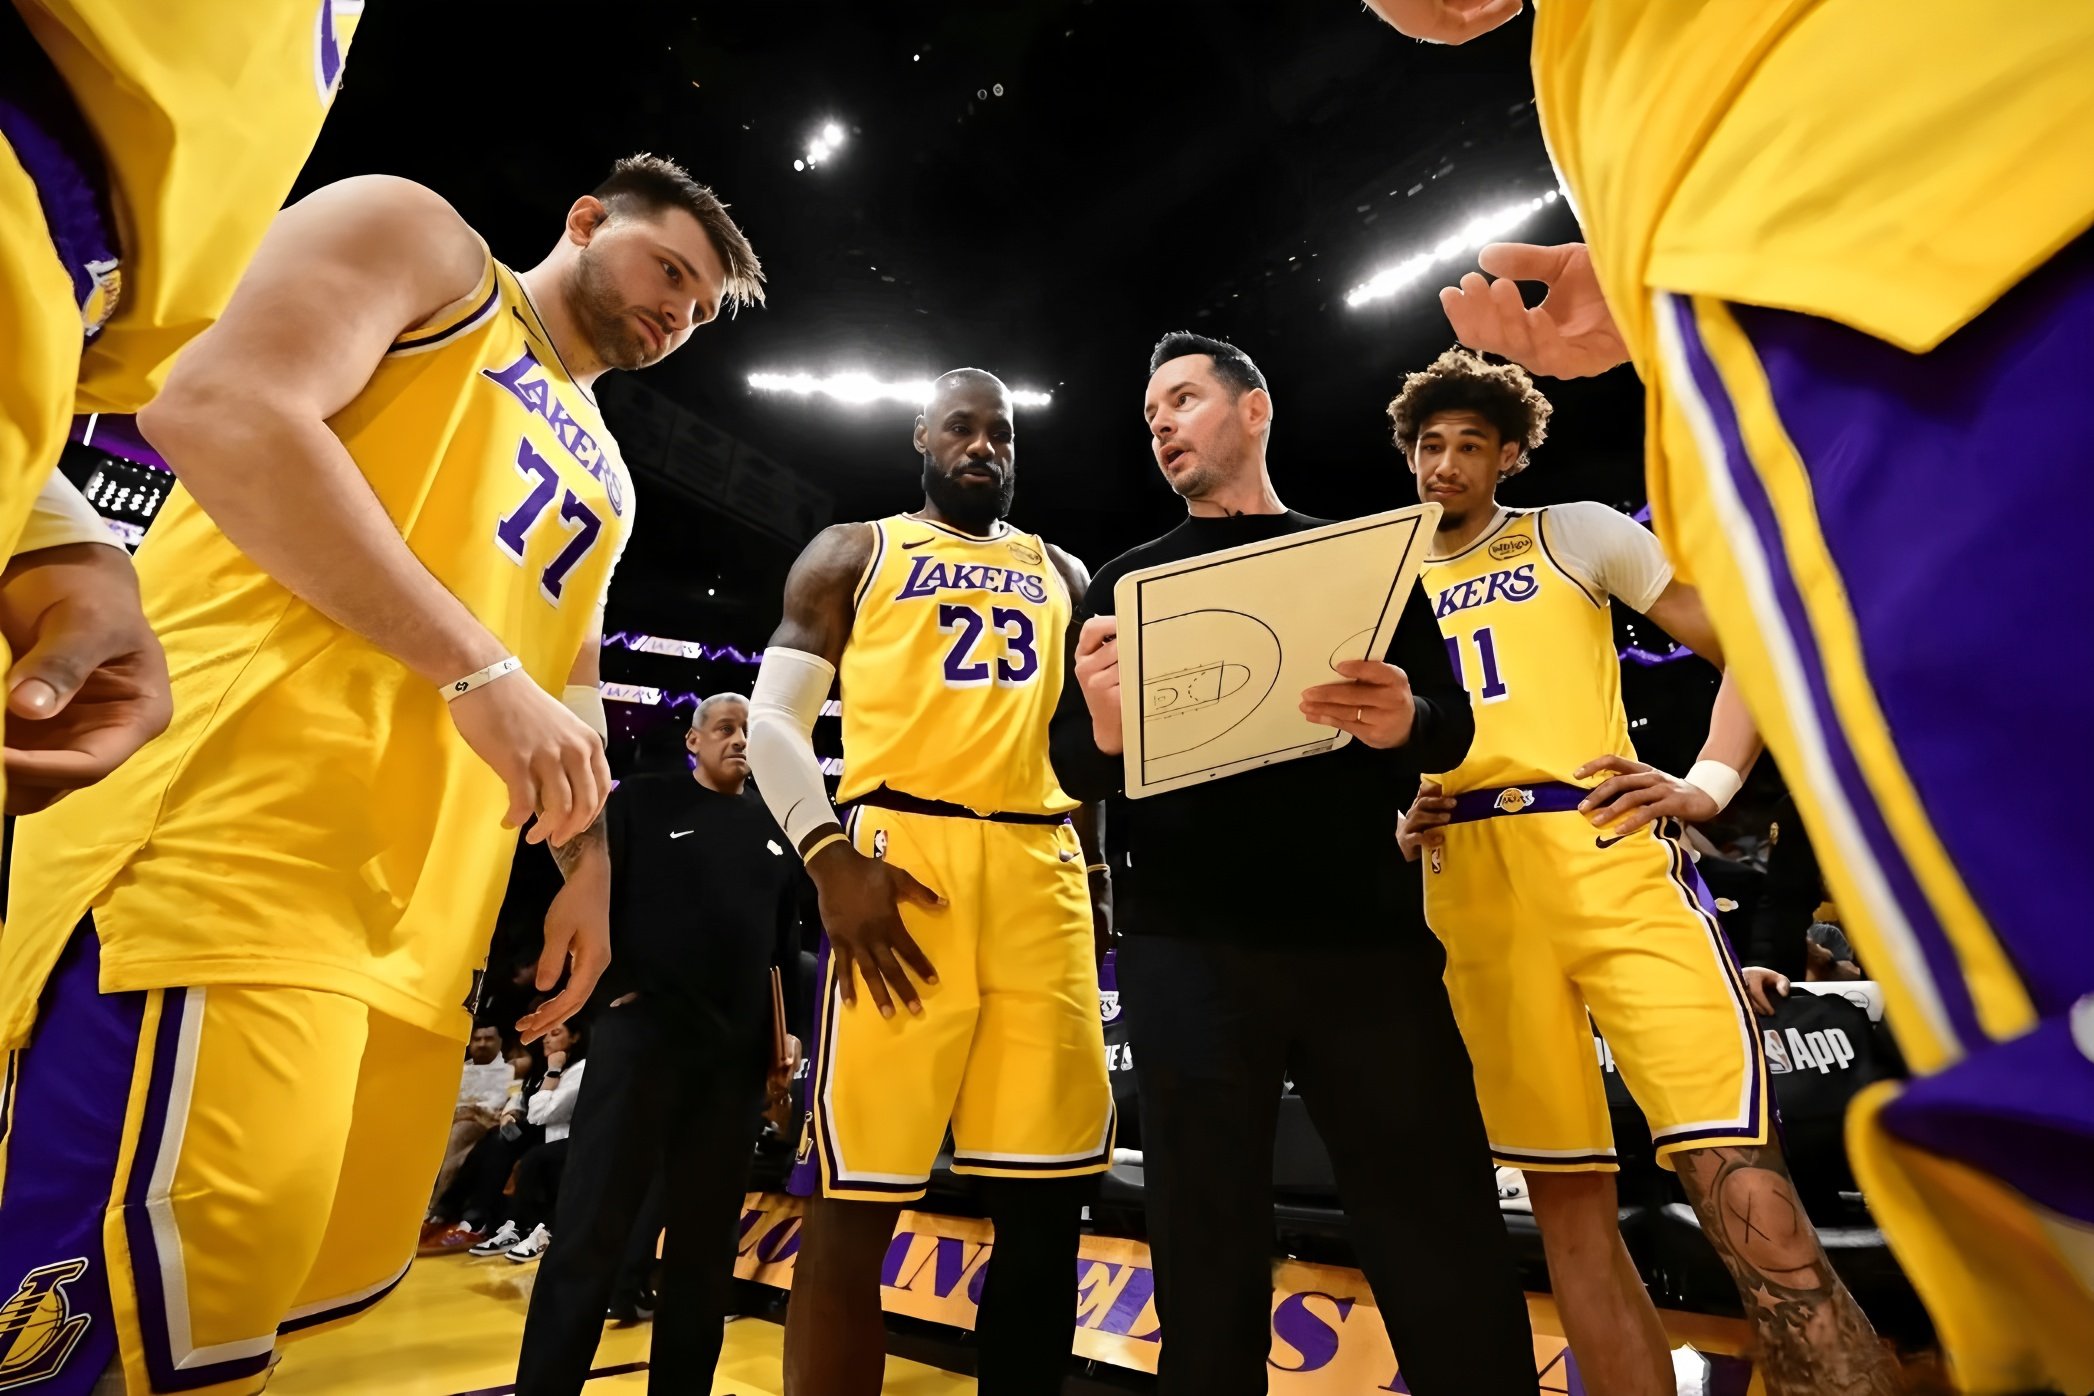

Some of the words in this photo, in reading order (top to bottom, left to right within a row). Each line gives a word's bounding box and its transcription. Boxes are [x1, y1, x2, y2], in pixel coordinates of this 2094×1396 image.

[479, 339, 623, 518] LAKERS
[494, 434, 602, 608] 77
[895, 555, 1048, 604] LAKERS
[1434, 563, 1540, 620] KERS
[938, 603, 1040, 686] 23
[1784, 1026, 1855, 1075] App
